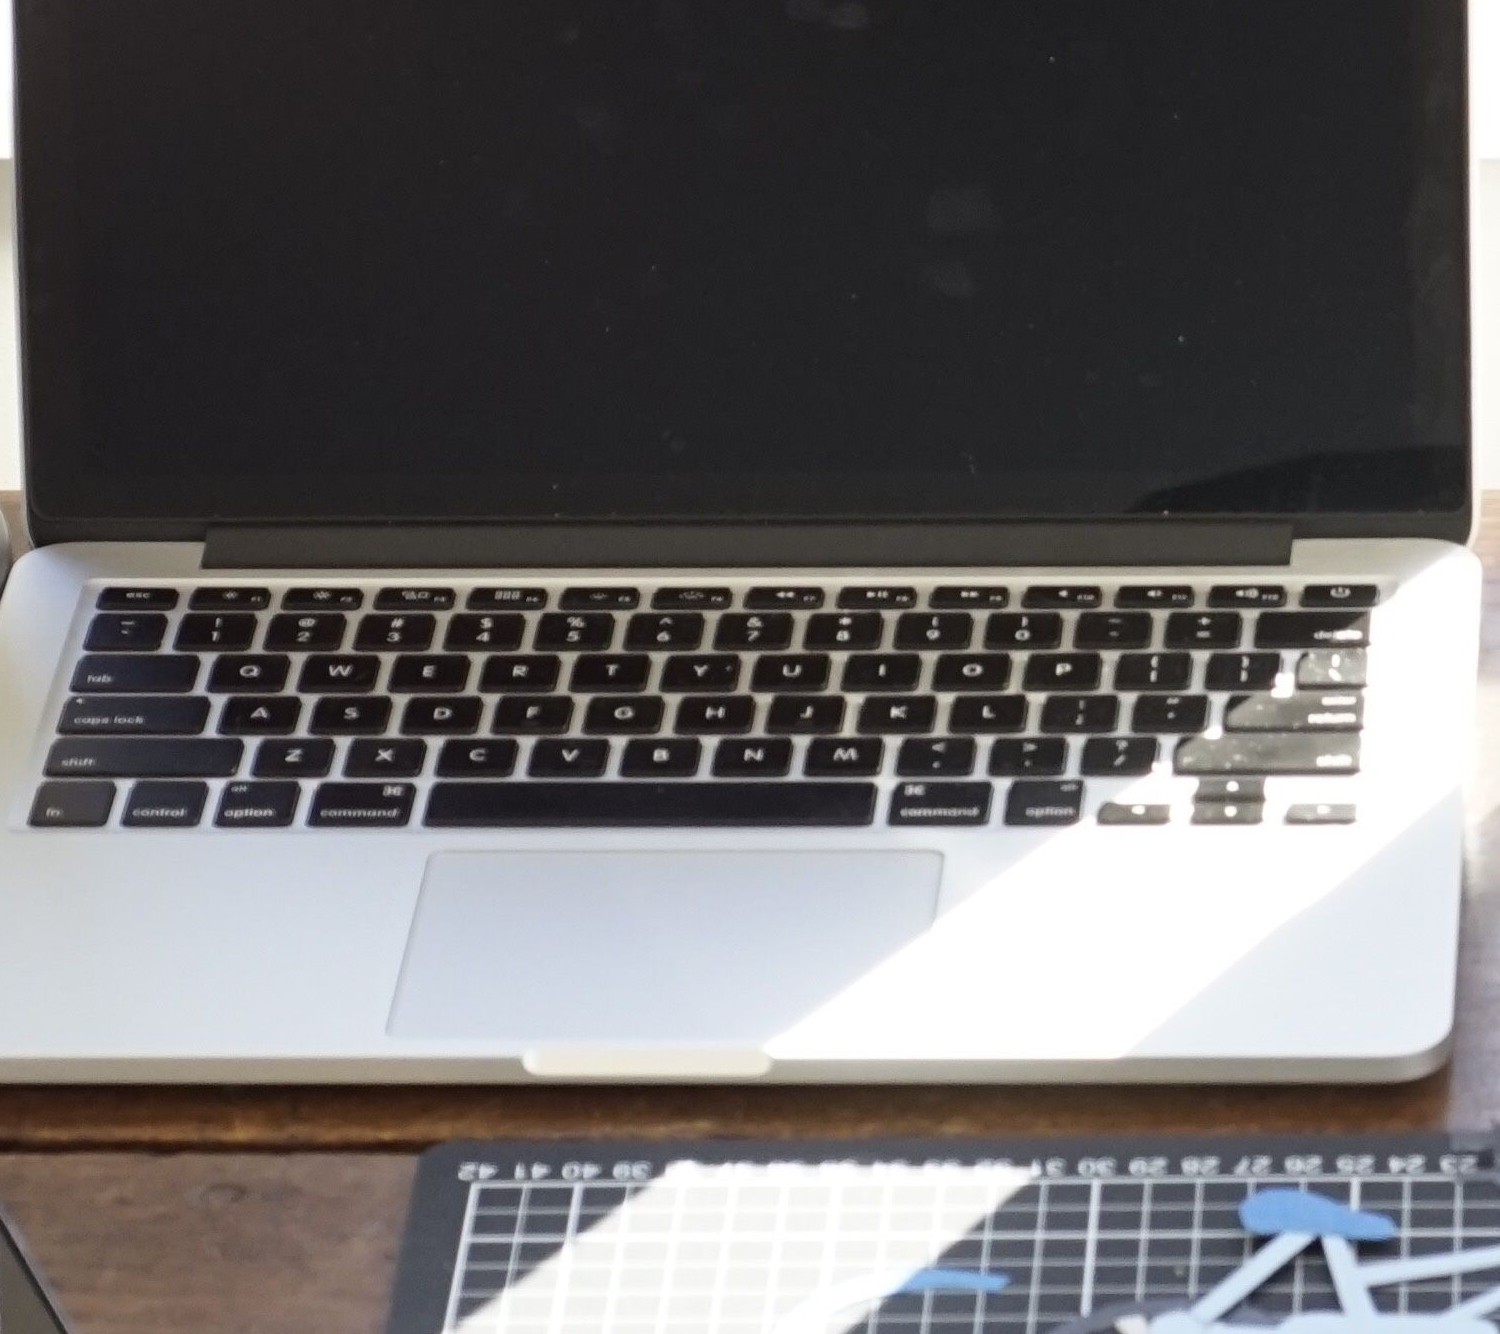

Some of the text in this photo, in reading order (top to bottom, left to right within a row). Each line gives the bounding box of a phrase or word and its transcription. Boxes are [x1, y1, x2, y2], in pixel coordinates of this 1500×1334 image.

[239, 665, 261, 678] Q
[328, 665, 353, 678] W
[422, 665, 437, 678] E
[512, 665, 528, 678] R
[605, 665, 620, 678] T
[693, 665, 708, 678] Y
[782, 665, 801, 678] U
[1055, 663, 1072, 676] P
[250, 706, 269, 719] A
[344, 706, 360, 719] S
[433, 706, 451, 719] D
[526, 706, 542, 719] F
[705, 706, 726, 719] H
[800, 706, 814, 719] J
[982, 705, 996, 718] L
[73, 715, 144, 726] caps lock
[284, 748, 303, 762] Z
[374, 748, 395, 762] X
[469, 748, 487, 762] C
[560, 748, 581, 762] V
[743, 748, 764, 762] N
[833, 748, 859, 762] M
[131, 806, 188, 818] control
[223, 806, 274, 820] option
[319, 806, 398, 818] command
[899, 806, 981, 818] command
